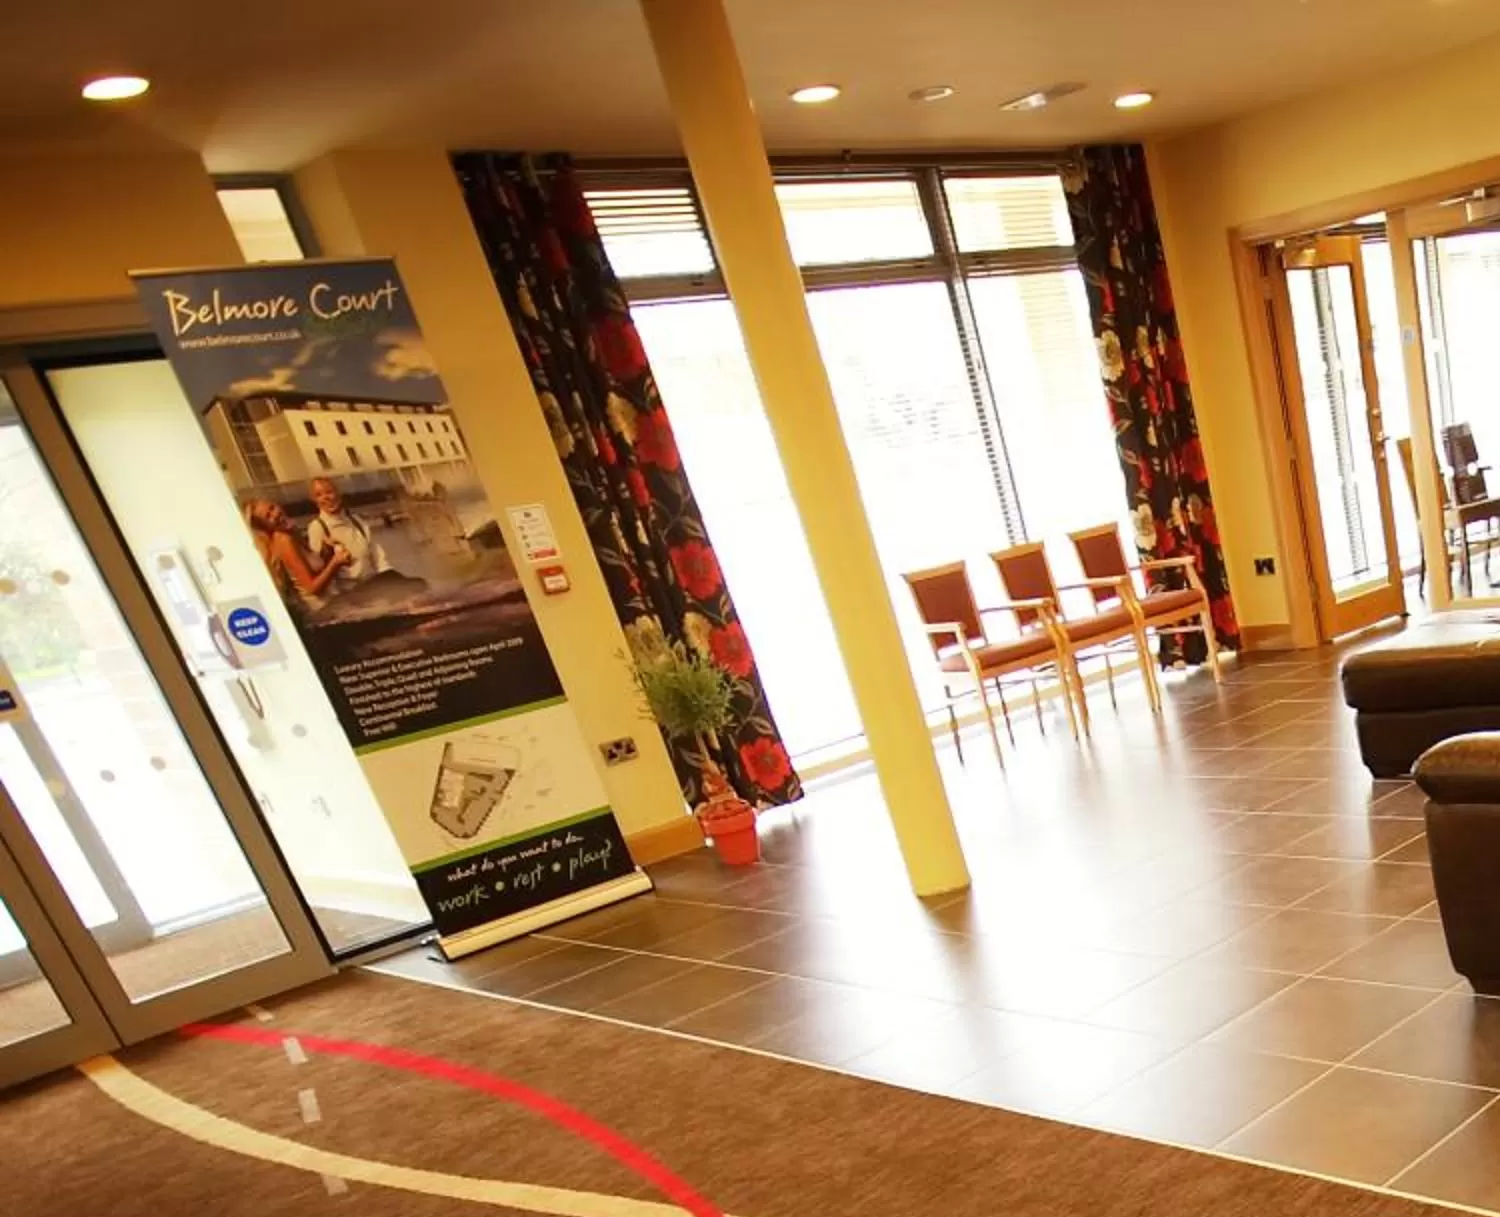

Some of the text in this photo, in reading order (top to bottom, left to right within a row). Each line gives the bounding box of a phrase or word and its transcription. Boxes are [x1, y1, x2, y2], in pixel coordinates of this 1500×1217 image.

[162, 288, 299, 336] Belmore
[308, 279, 399, 320] Court
[234, 616, 258, 628] KEEP
[436, 838, 613, 914] work rest play?
[447, 862, 478, 882] what
[480, 856, 495, 873] do
[496, 853, 517, 873] you
[518, 840, 549, 860] want
[551, 838, 563, 850] to
